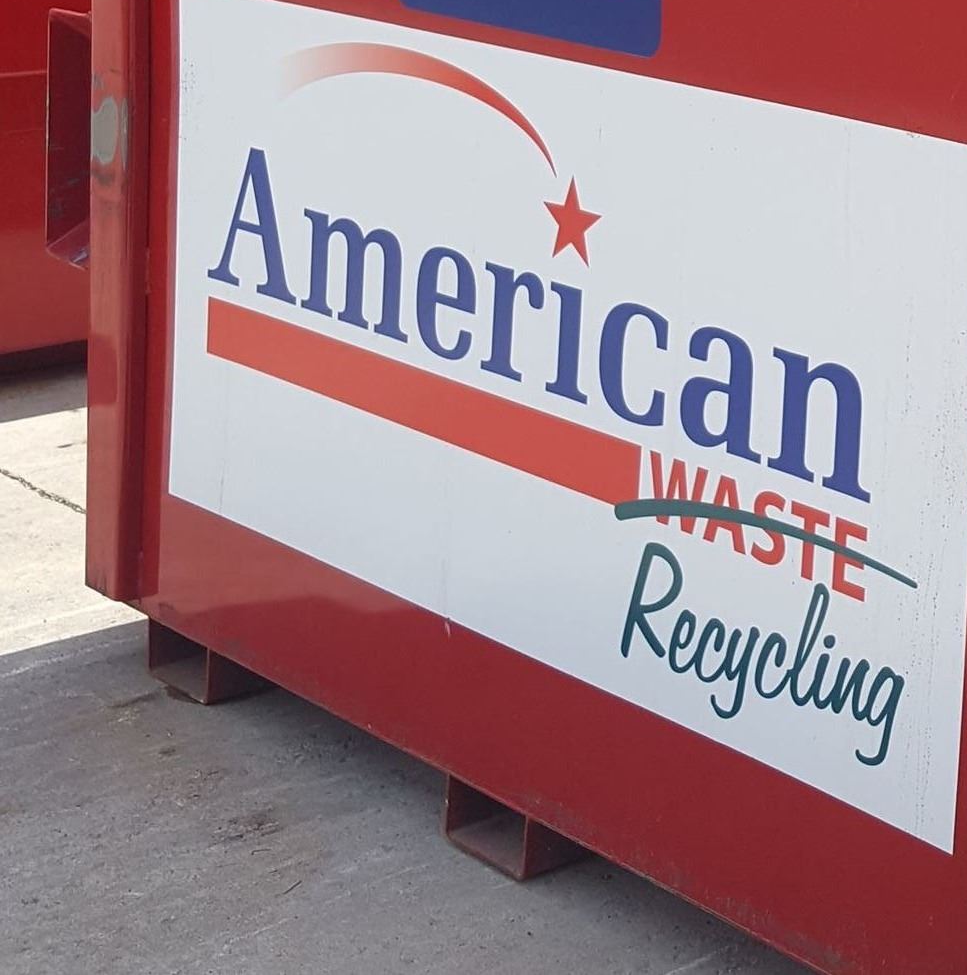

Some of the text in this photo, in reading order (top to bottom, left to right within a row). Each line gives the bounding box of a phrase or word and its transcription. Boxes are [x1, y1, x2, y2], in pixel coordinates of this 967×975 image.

[207, 146, 871, 504] American
[649, 450, 869, 603] WASTE
[620, 541, 905, 766] Recycling
